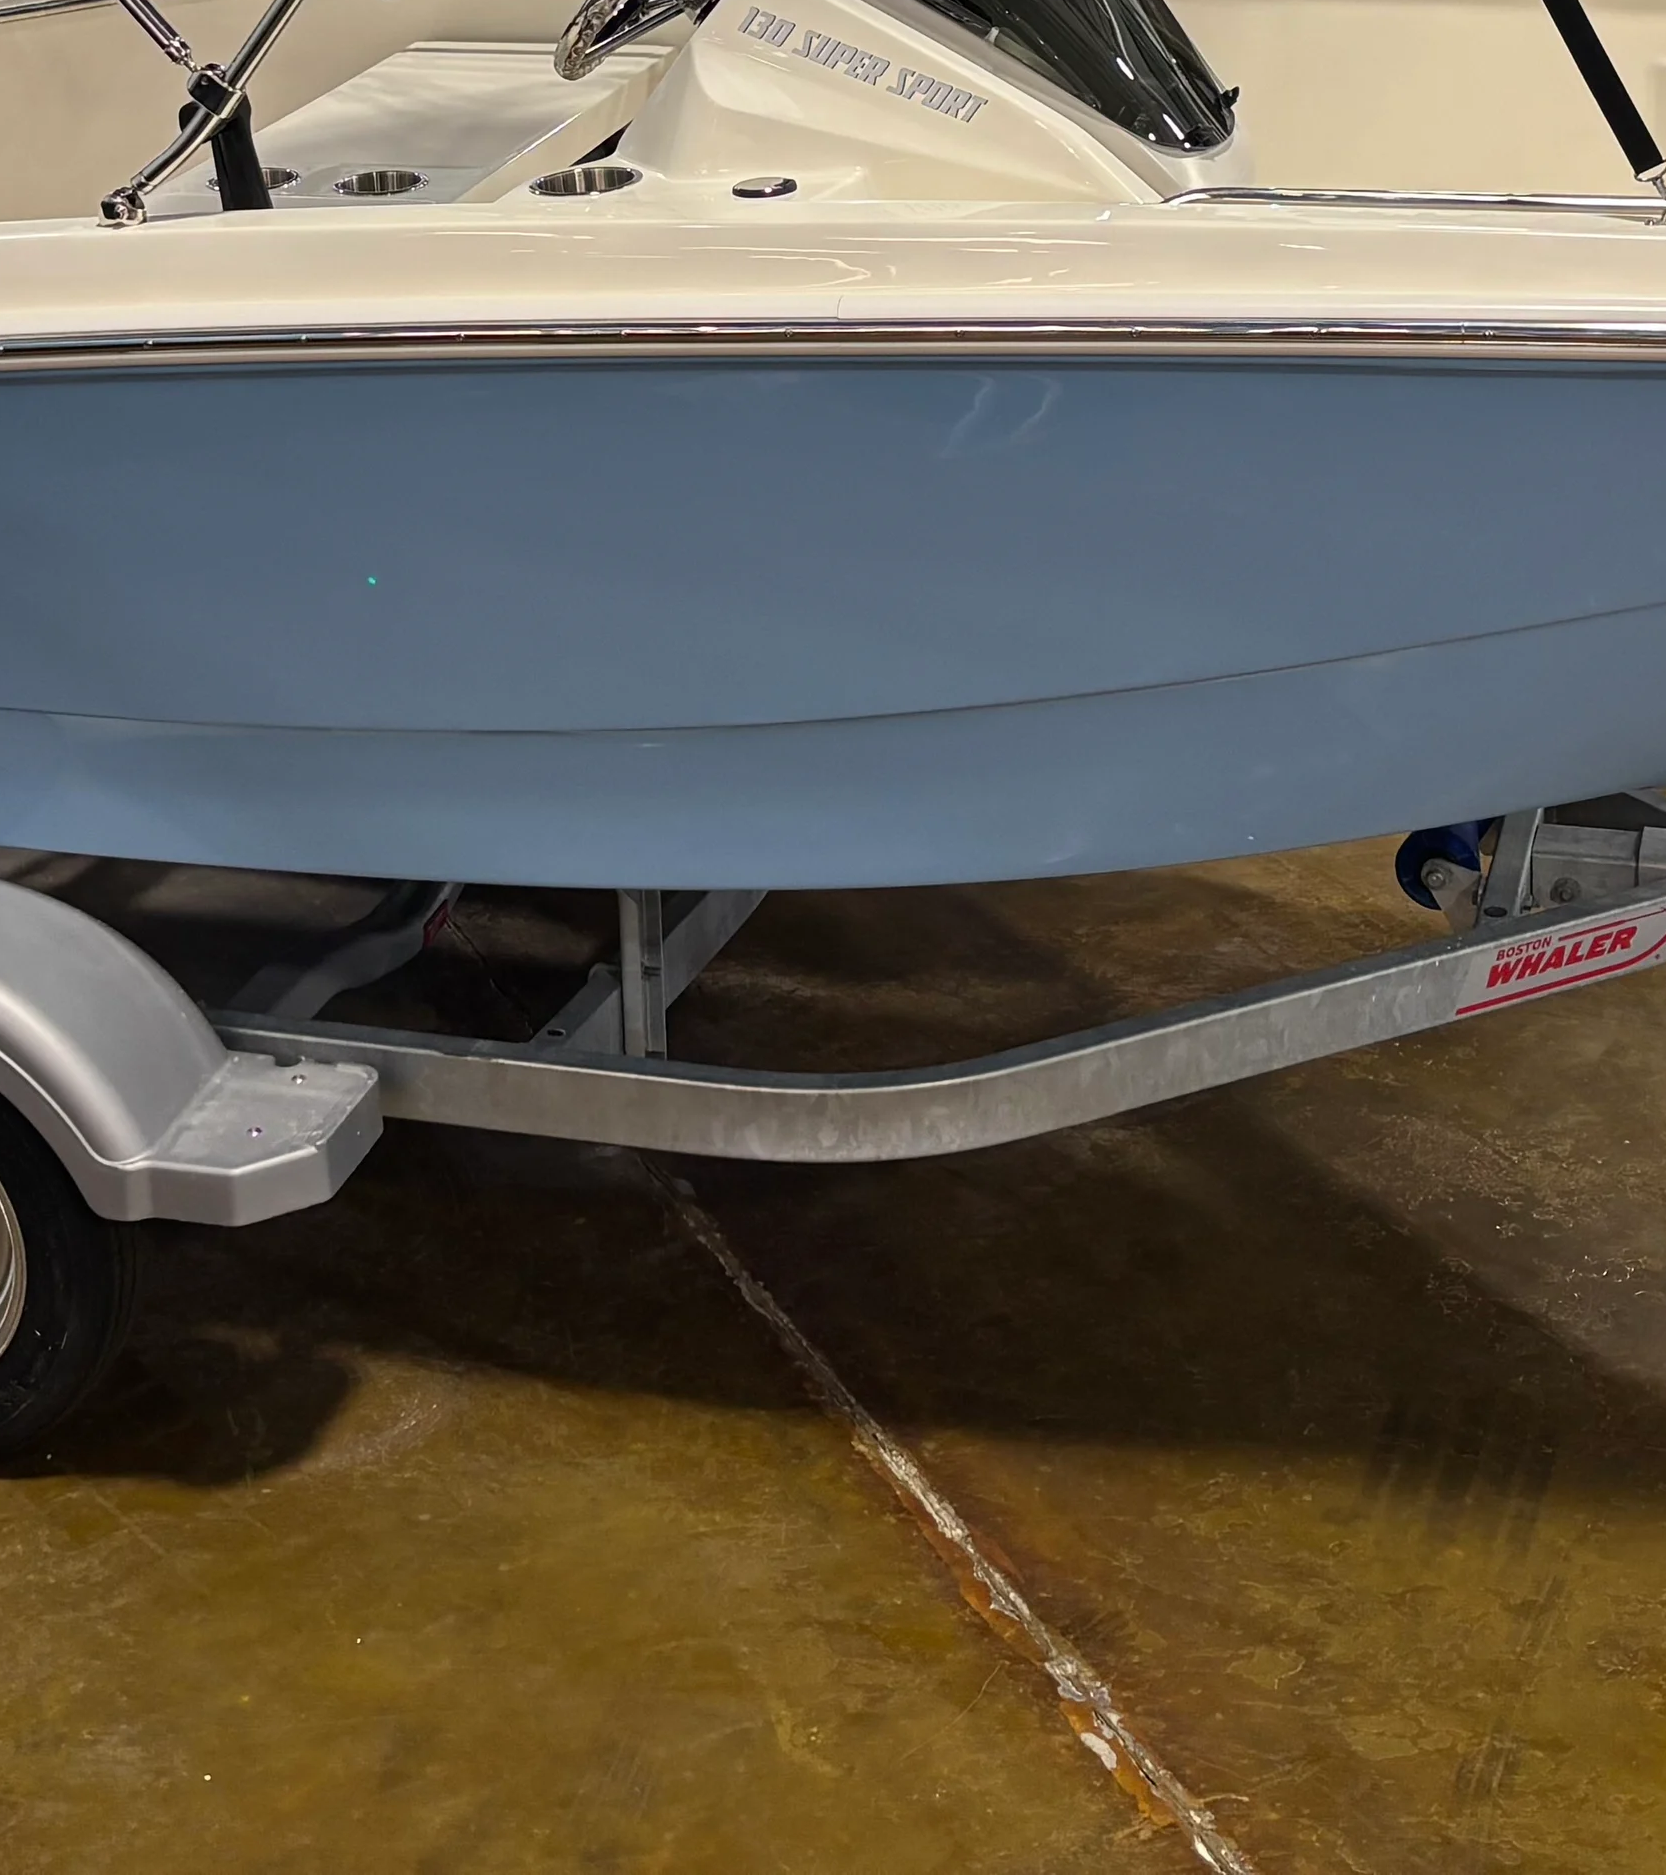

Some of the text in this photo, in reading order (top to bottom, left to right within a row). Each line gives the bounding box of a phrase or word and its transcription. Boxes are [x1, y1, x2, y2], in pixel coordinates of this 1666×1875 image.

[737, 5, 989, 124] 130 SUPER SPORT
[1485, 925, 1638, 990] WHALER
[1495, 935, 1553, 962] BOSTON
